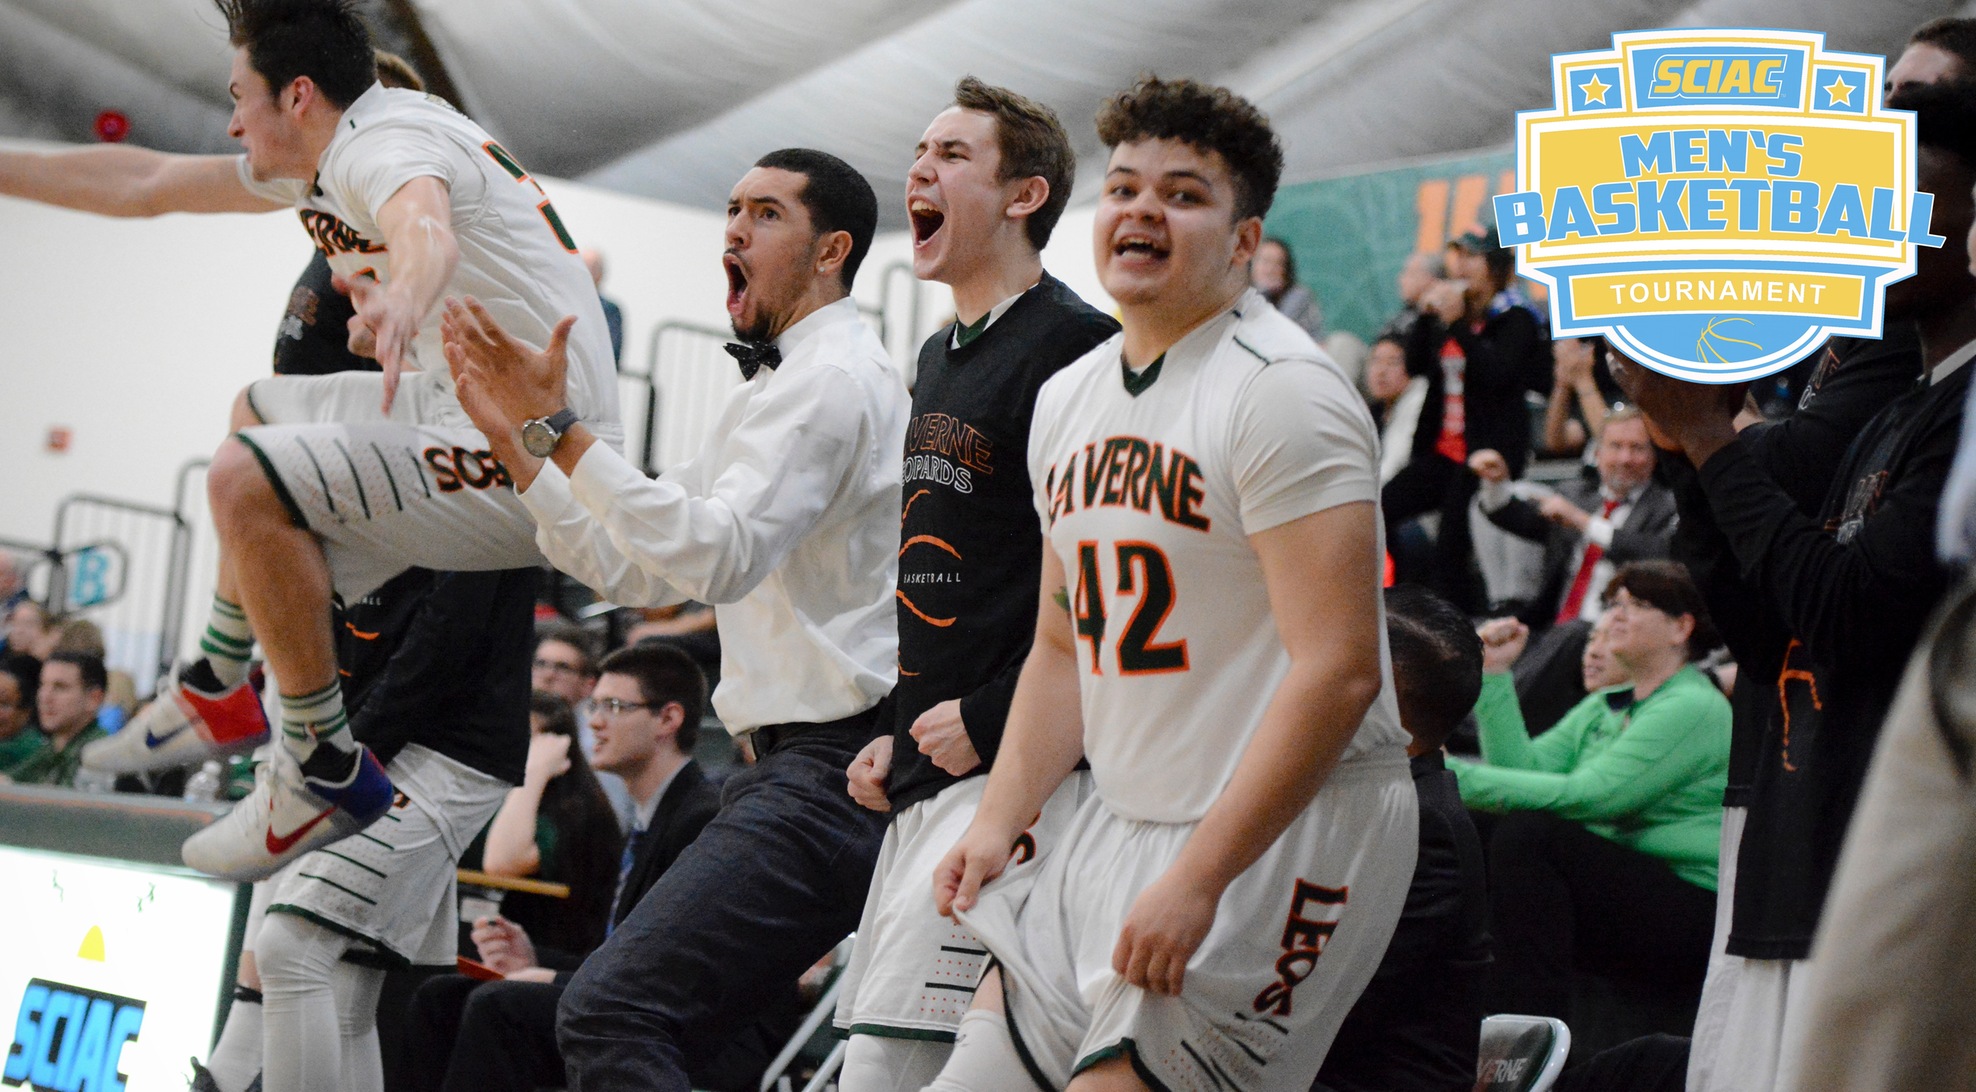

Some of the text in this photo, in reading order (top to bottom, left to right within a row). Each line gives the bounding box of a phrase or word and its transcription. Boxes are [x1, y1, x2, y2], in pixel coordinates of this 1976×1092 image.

[1083, 435, 1212, 533] VERNE
[1074, 539, 1191, 677] 42
[1252, 877, 1349, 1018] LEOS
[2, 979, 146, 1092] SCIAC
